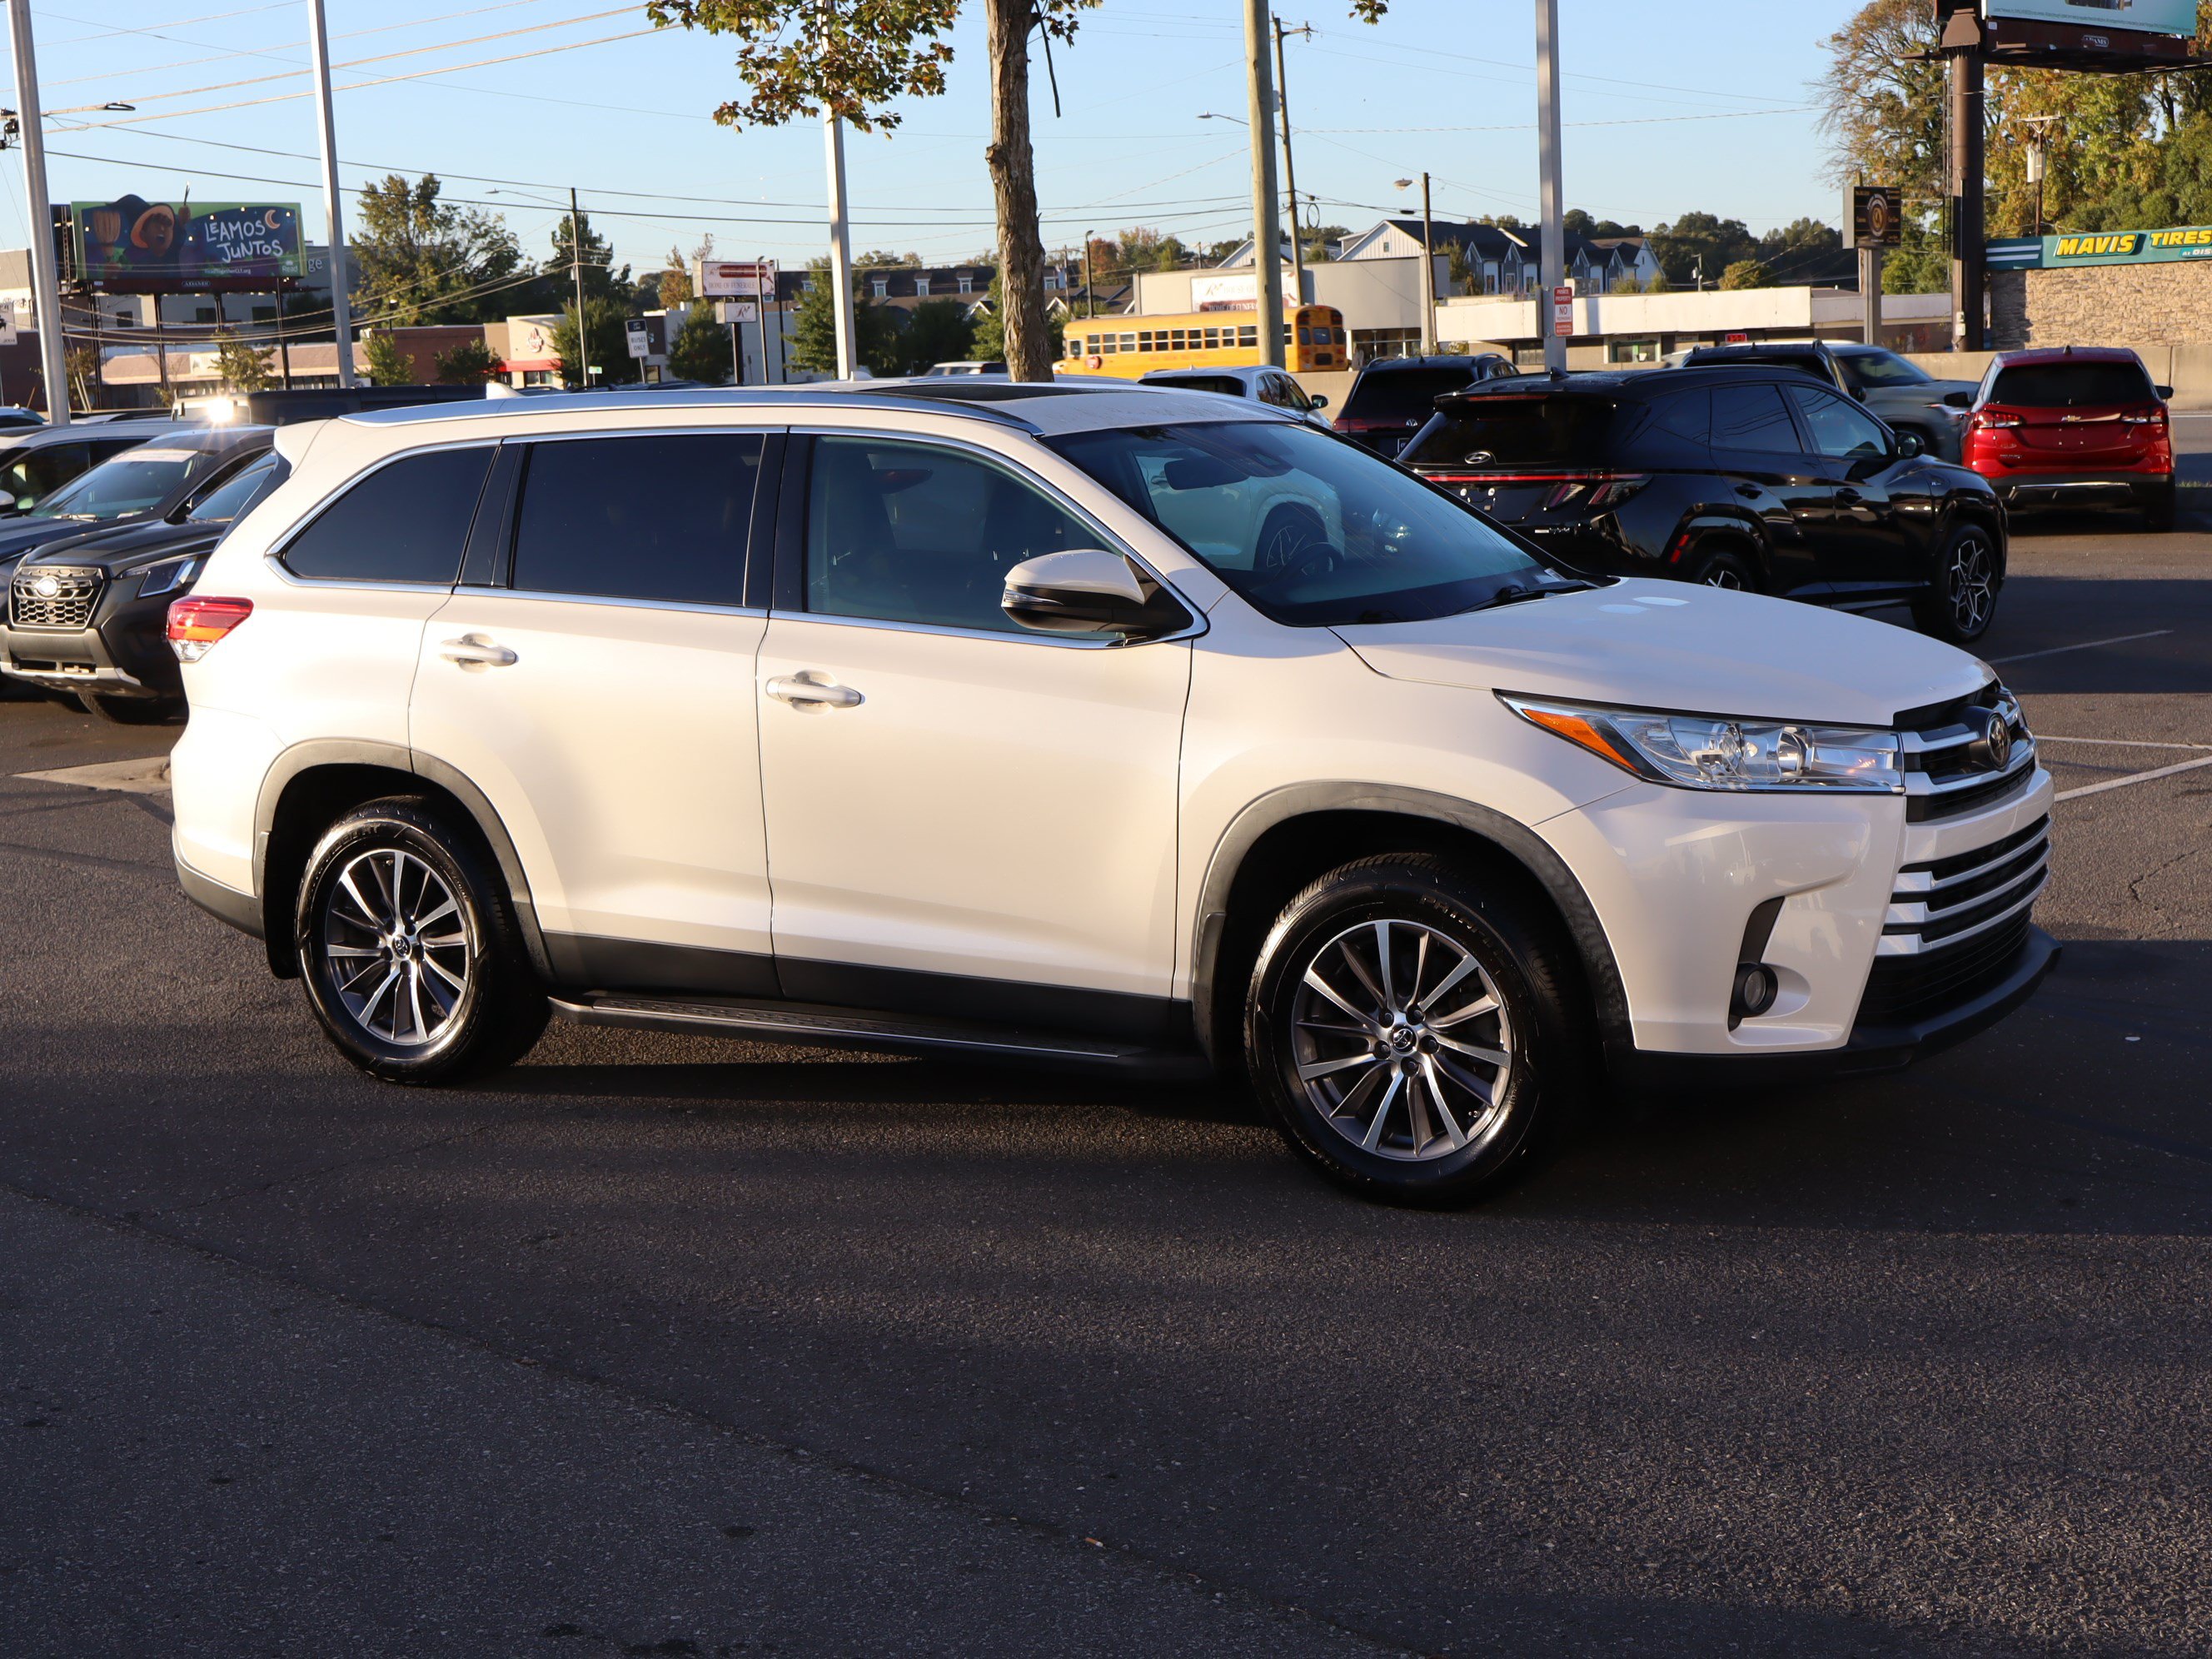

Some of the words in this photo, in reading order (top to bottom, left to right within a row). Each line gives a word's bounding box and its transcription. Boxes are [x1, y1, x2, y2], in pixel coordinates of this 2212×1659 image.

[205, 220, 266, 242] LEAMOS
[2150, 230, 2212, 247] TIRES
[217, 239, 284, 263] JUNTOS
[2056, 234, 2136, 255] MAVIS
[1559, 306, 1567, 315] NO
